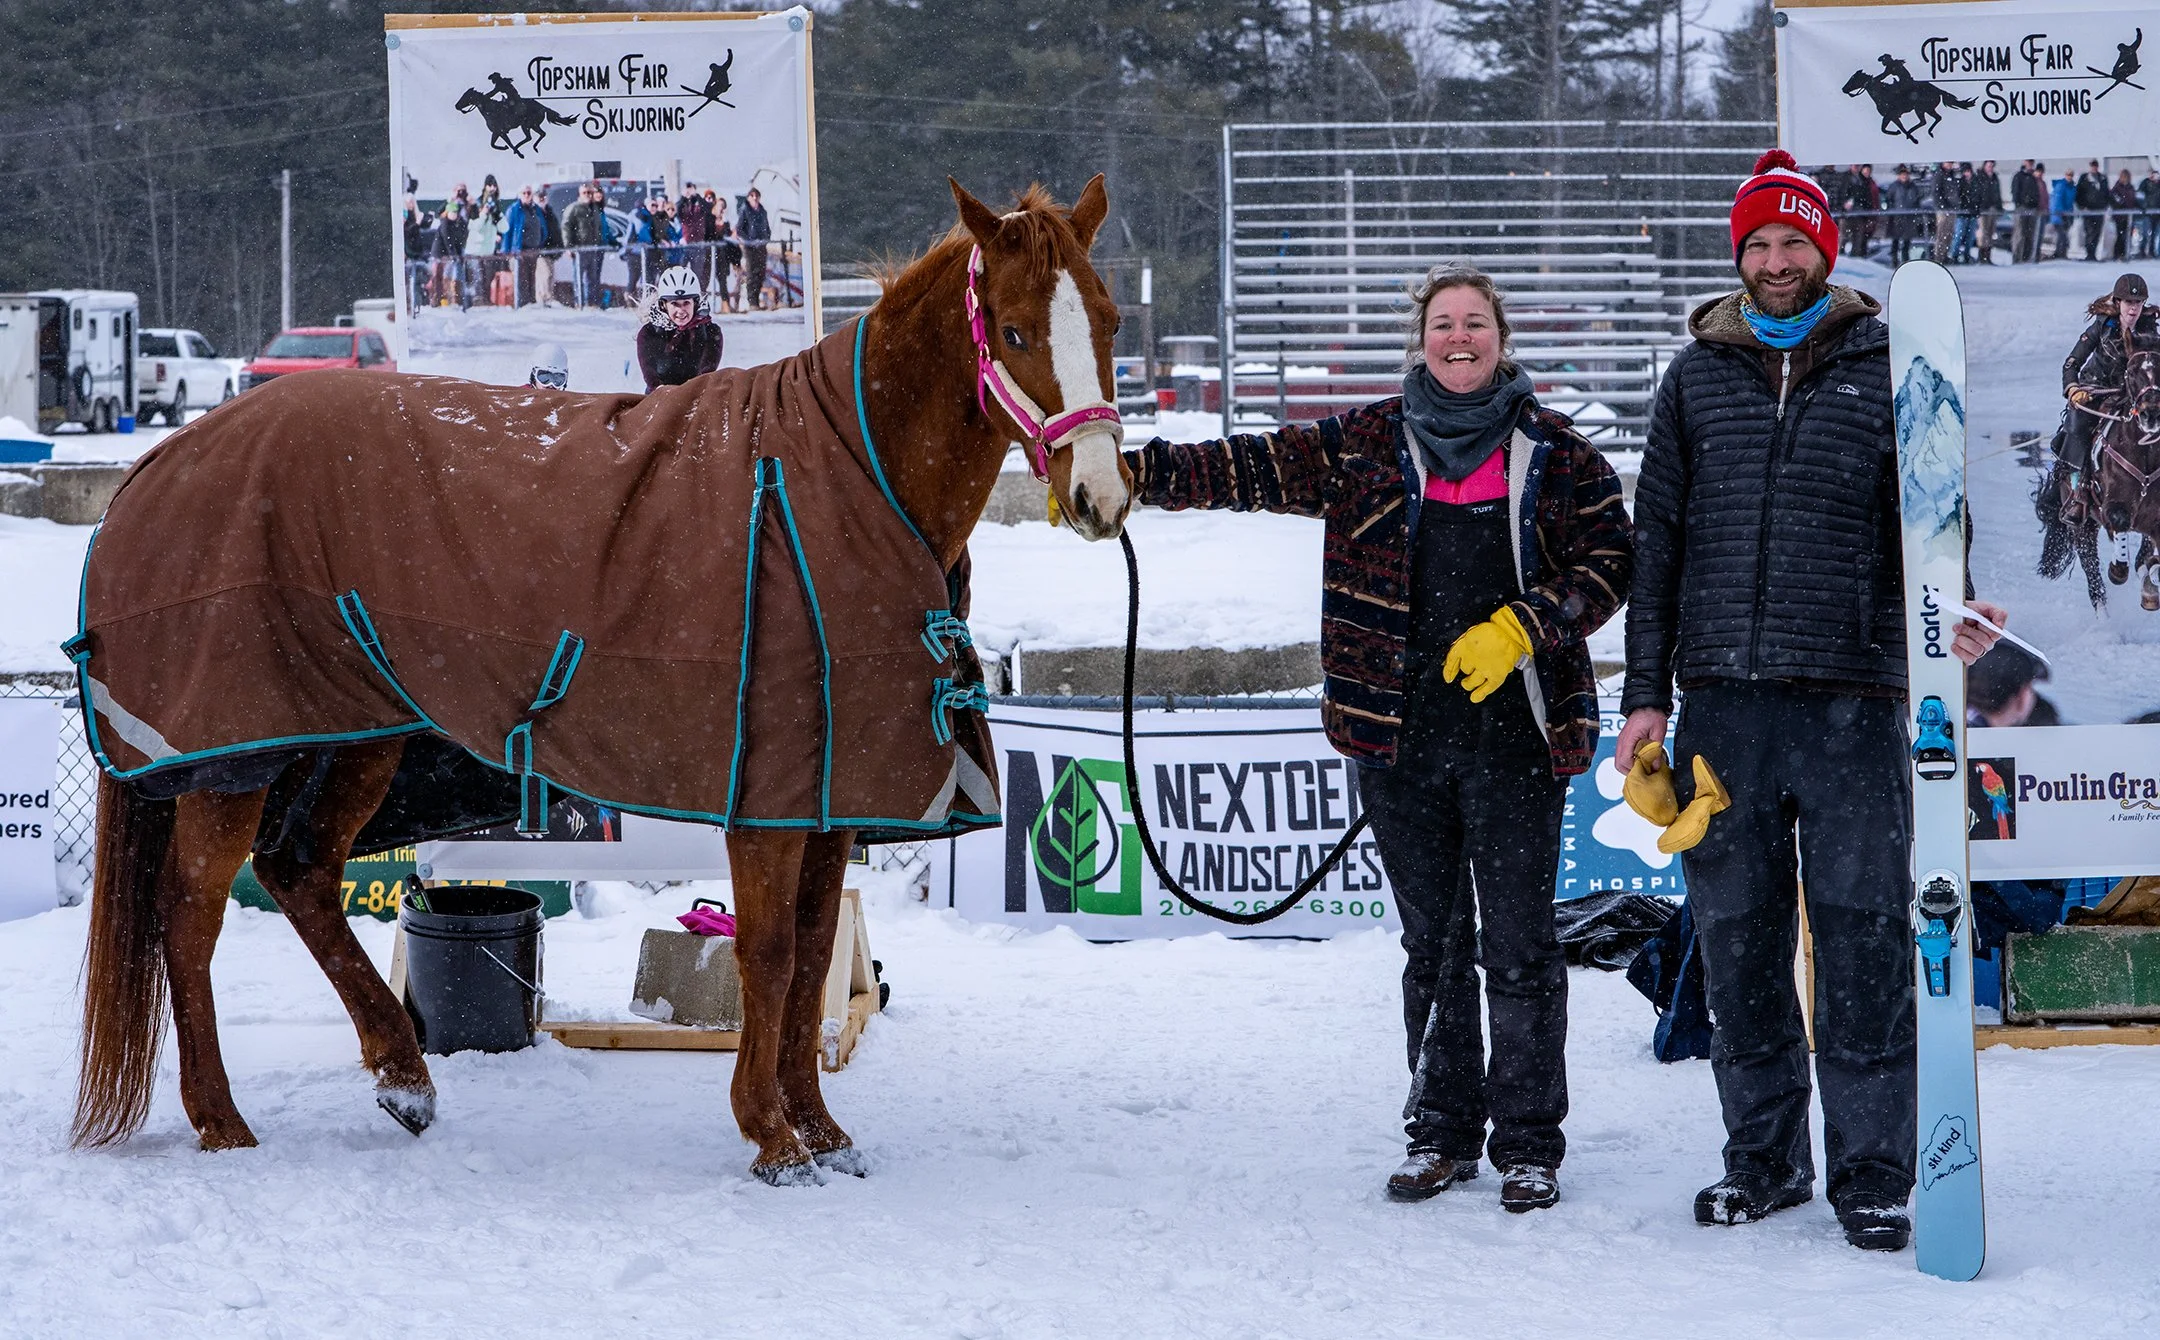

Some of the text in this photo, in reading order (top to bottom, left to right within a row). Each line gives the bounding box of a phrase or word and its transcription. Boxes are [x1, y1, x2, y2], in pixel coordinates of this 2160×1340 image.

[1779, 192, 1822, 234] USA
[2117, 813, 2144, 822] Family
[0, 823, 42, 839] ers
[1159, 899, 1385, 919] 20-26-6300
[1928, 1127, 1962, 1170] ski kind
